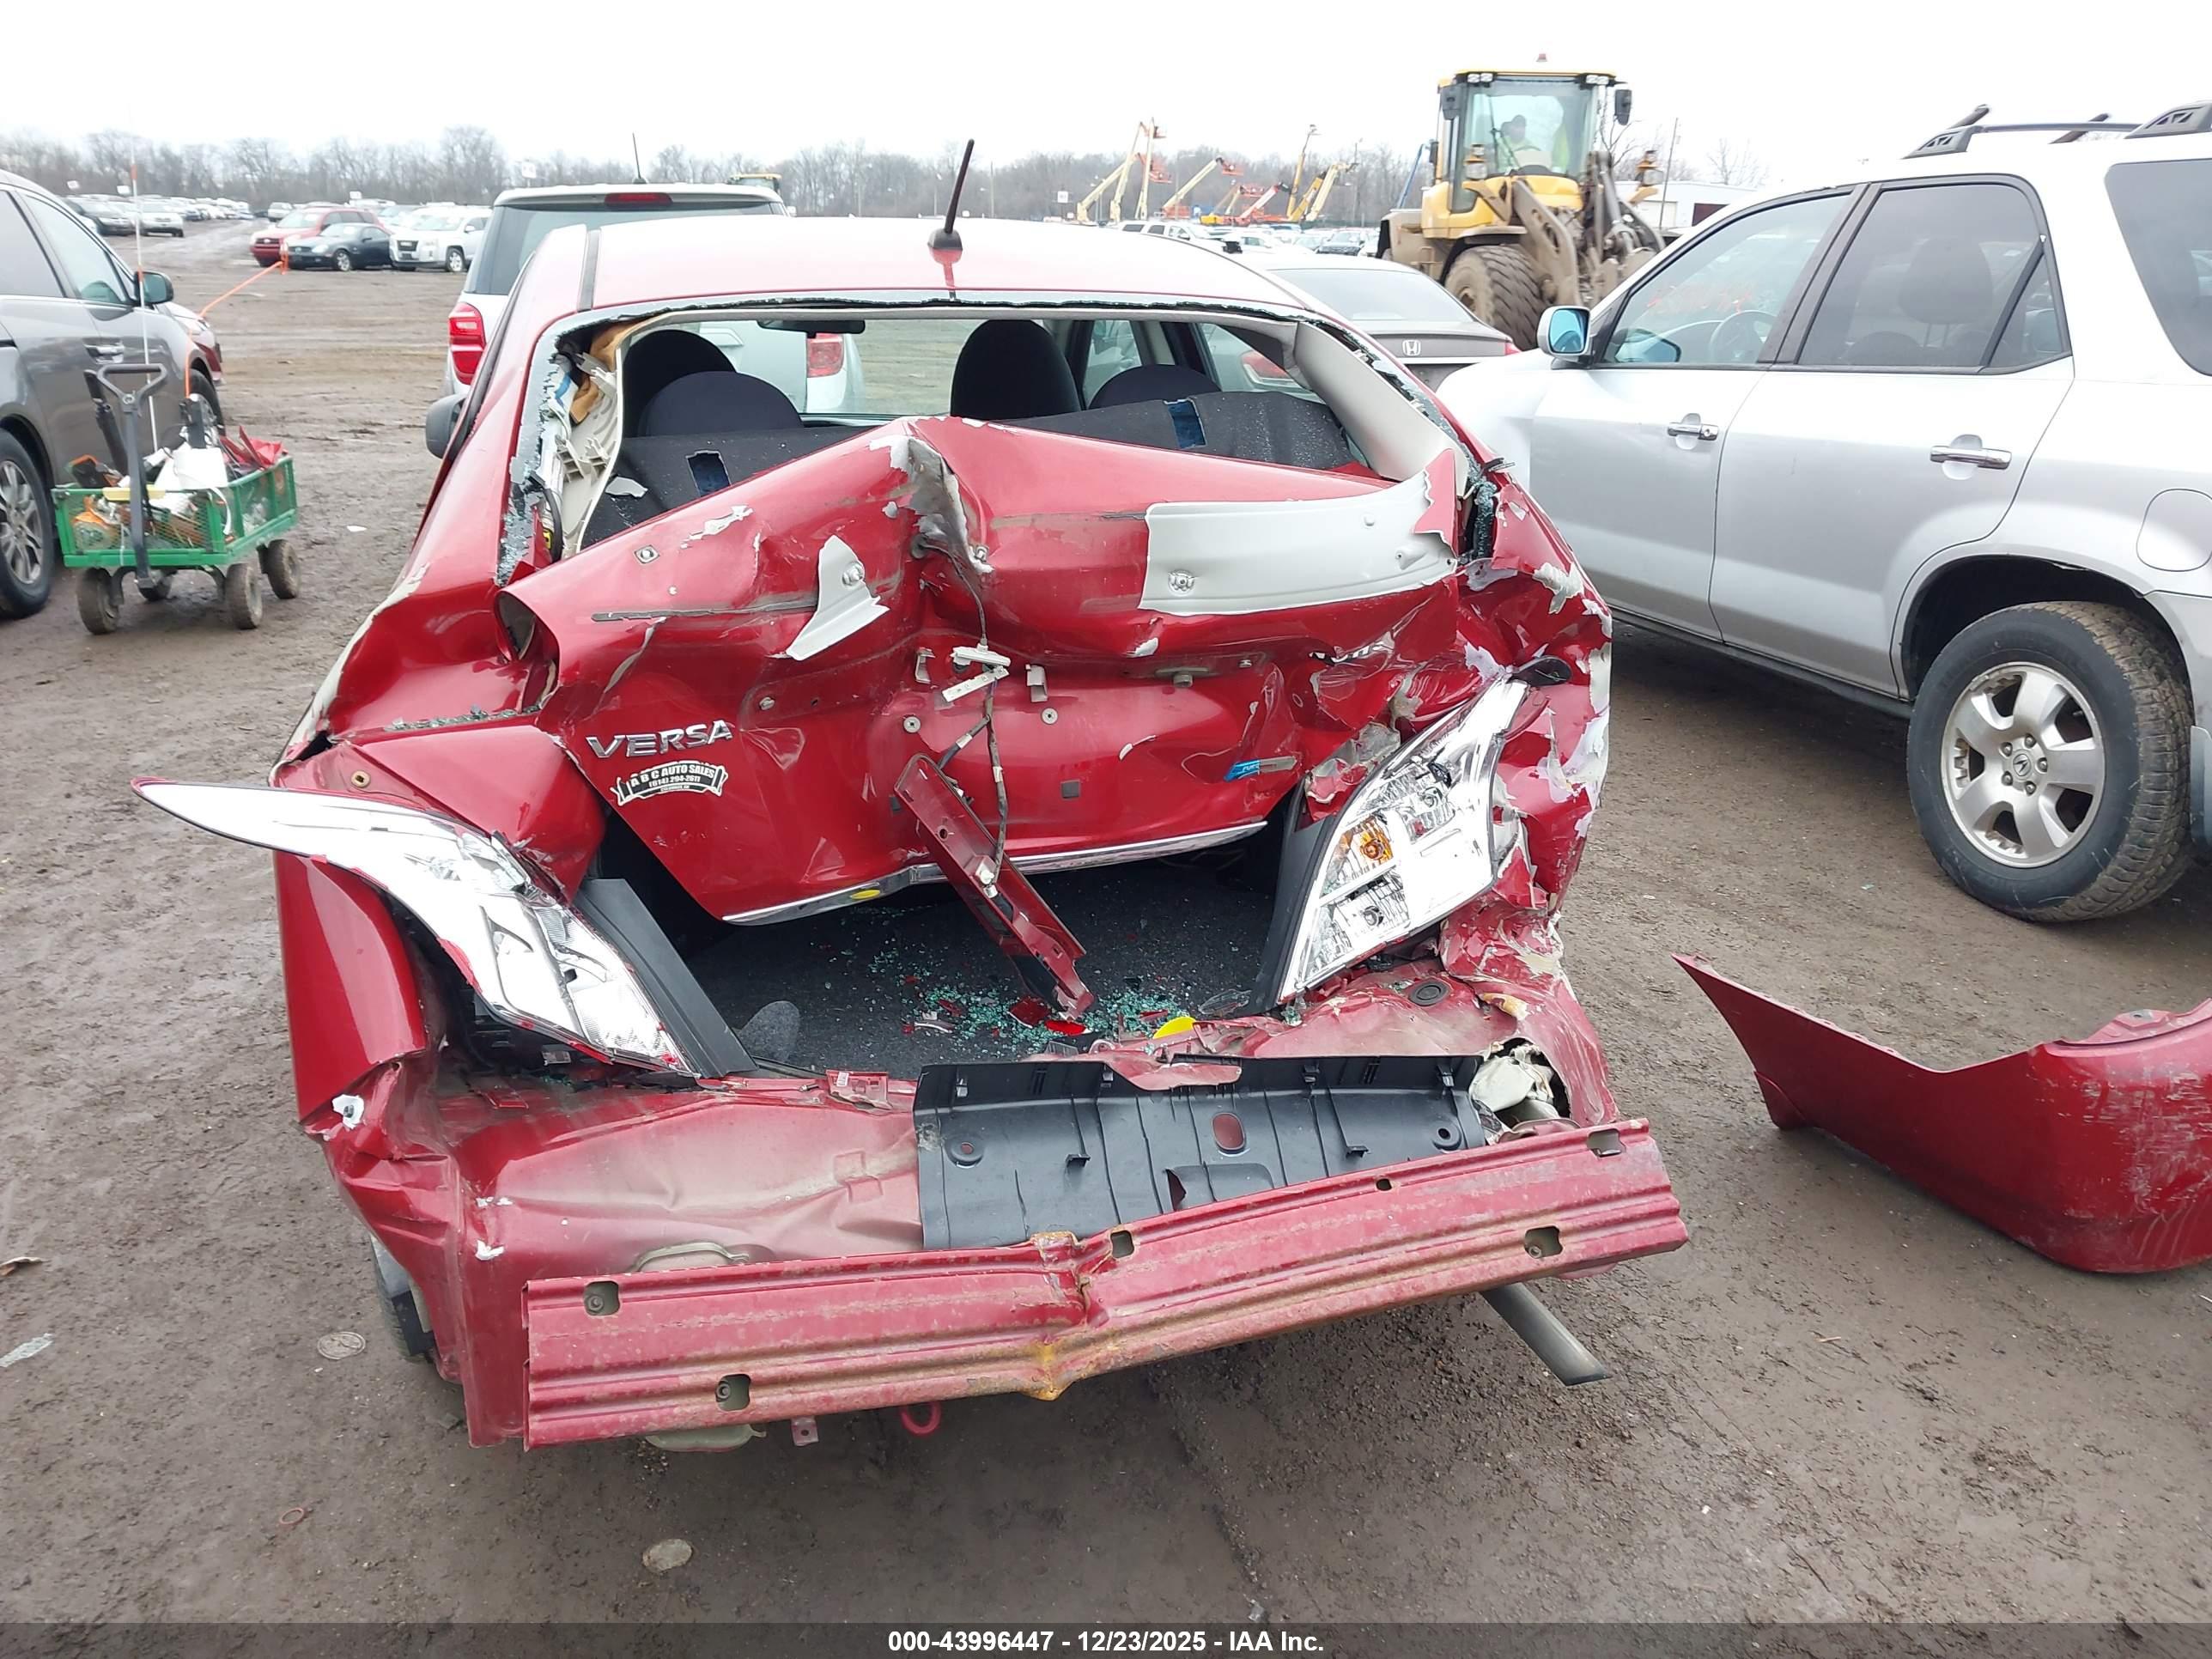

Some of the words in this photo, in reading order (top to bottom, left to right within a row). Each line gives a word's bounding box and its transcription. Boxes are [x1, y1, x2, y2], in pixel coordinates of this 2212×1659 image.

[586, 720, 732, 758] VERSA
[631, 777, 641, 787] A
[641, 774, 650, 783] B
[651, 770, 660, 780] C
[661, 764, 688, 777] AUTO
[689, 764, 715, 779] SALES
[648, 776, 670, 787] (614)
